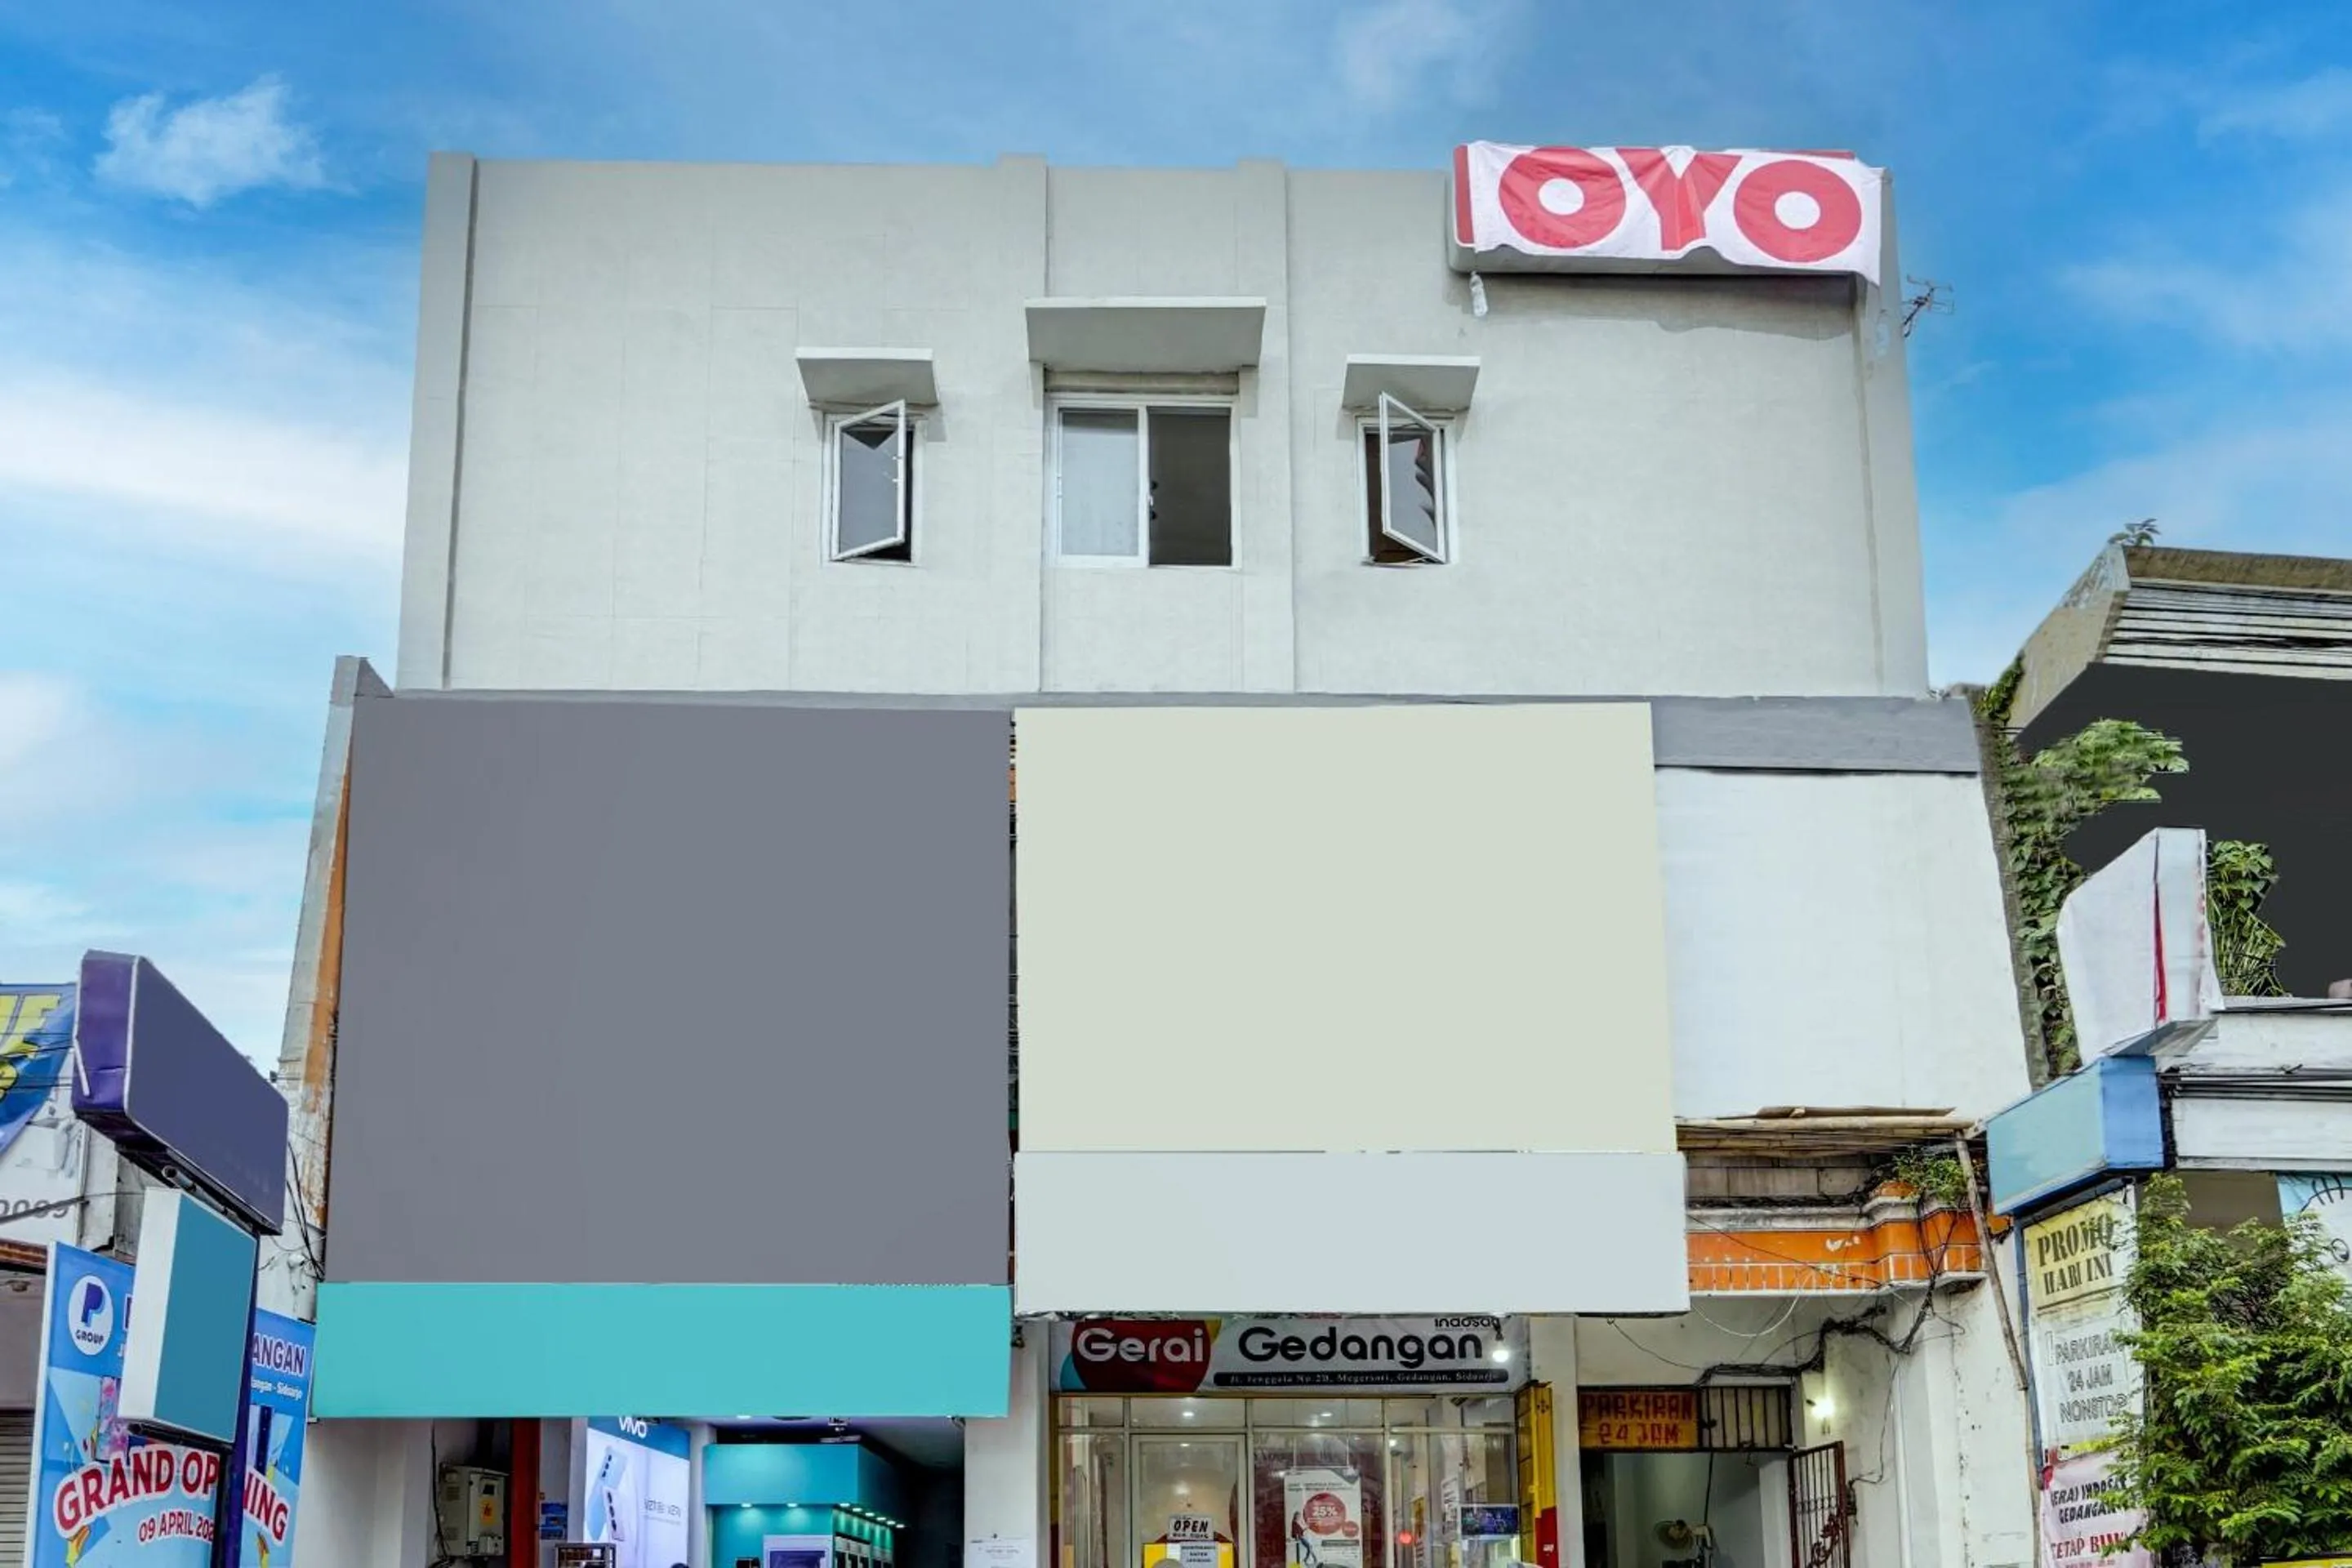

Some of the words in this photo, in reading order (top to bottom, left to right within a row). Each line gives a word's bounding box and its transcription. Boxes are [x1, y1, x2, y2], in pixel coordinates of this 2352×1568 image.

[1498, 145, 1863, 264] OYO
[2037, 1212, 2114, 1267] PROMO
[2043, 1262, 2082, 1295] HARI
[2086, 1253, 2114, 1282] INI
[81, 1281, 104, 1327] P
[75, 1330, 104, 1343] GROUP
[1076, 1327, 1204, 1363] Gerai
[1237, 1326, 1483, 1369] Gedangan
[2067, 1369, 2084, 1392] 24
[2086, 1363, 2114, 1390] JAM
[1579, 1392, 1693, 1420] PARKIRAN
[1598, 1423, 1628, 1444] 24
[1637, 1423, 1680, 1445] JAM
[56, 1450, 176, 1531] GRAND
[139, 1517, 155, 1542] 09
[158, 1511, 194, 1537] APRIL
[1174, 1520, 1209, 1533] OPEN
